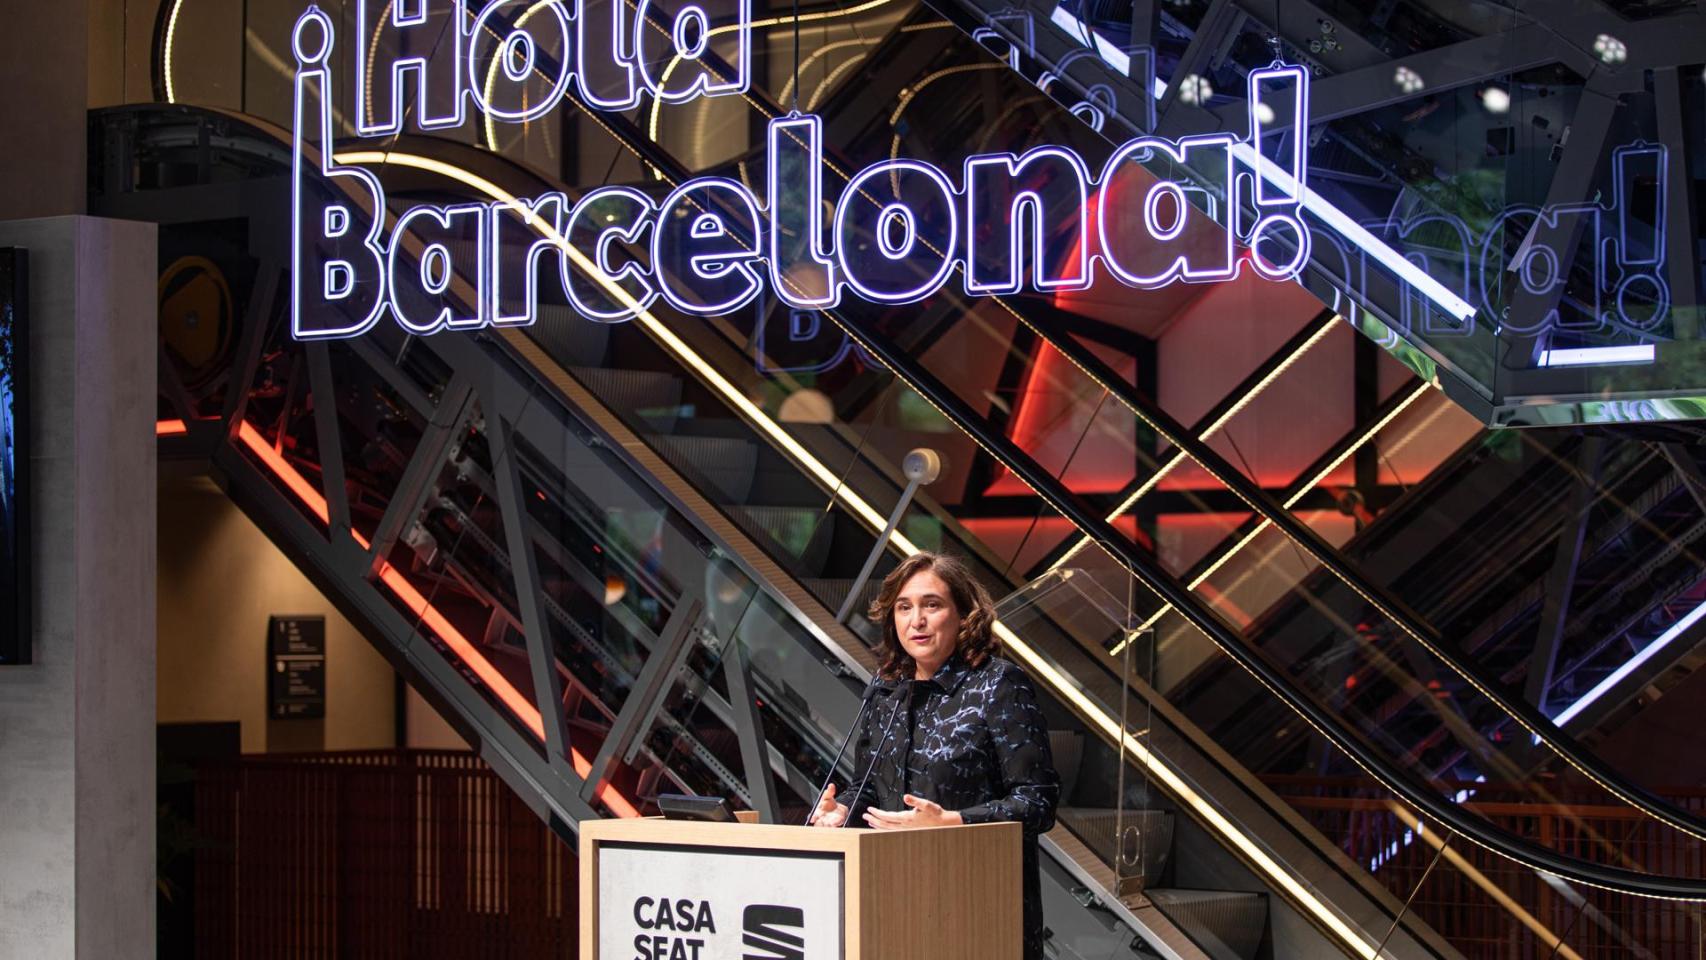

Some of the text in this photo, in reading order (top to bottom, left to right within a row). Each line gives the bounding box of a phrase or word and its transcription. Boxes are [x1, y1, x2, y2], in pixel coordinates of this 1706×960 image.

[292, 62, 1311, 340] Barcelona!
[633, 896, 716, 934] CASA
[633, 934, 704, 960] SEAT
